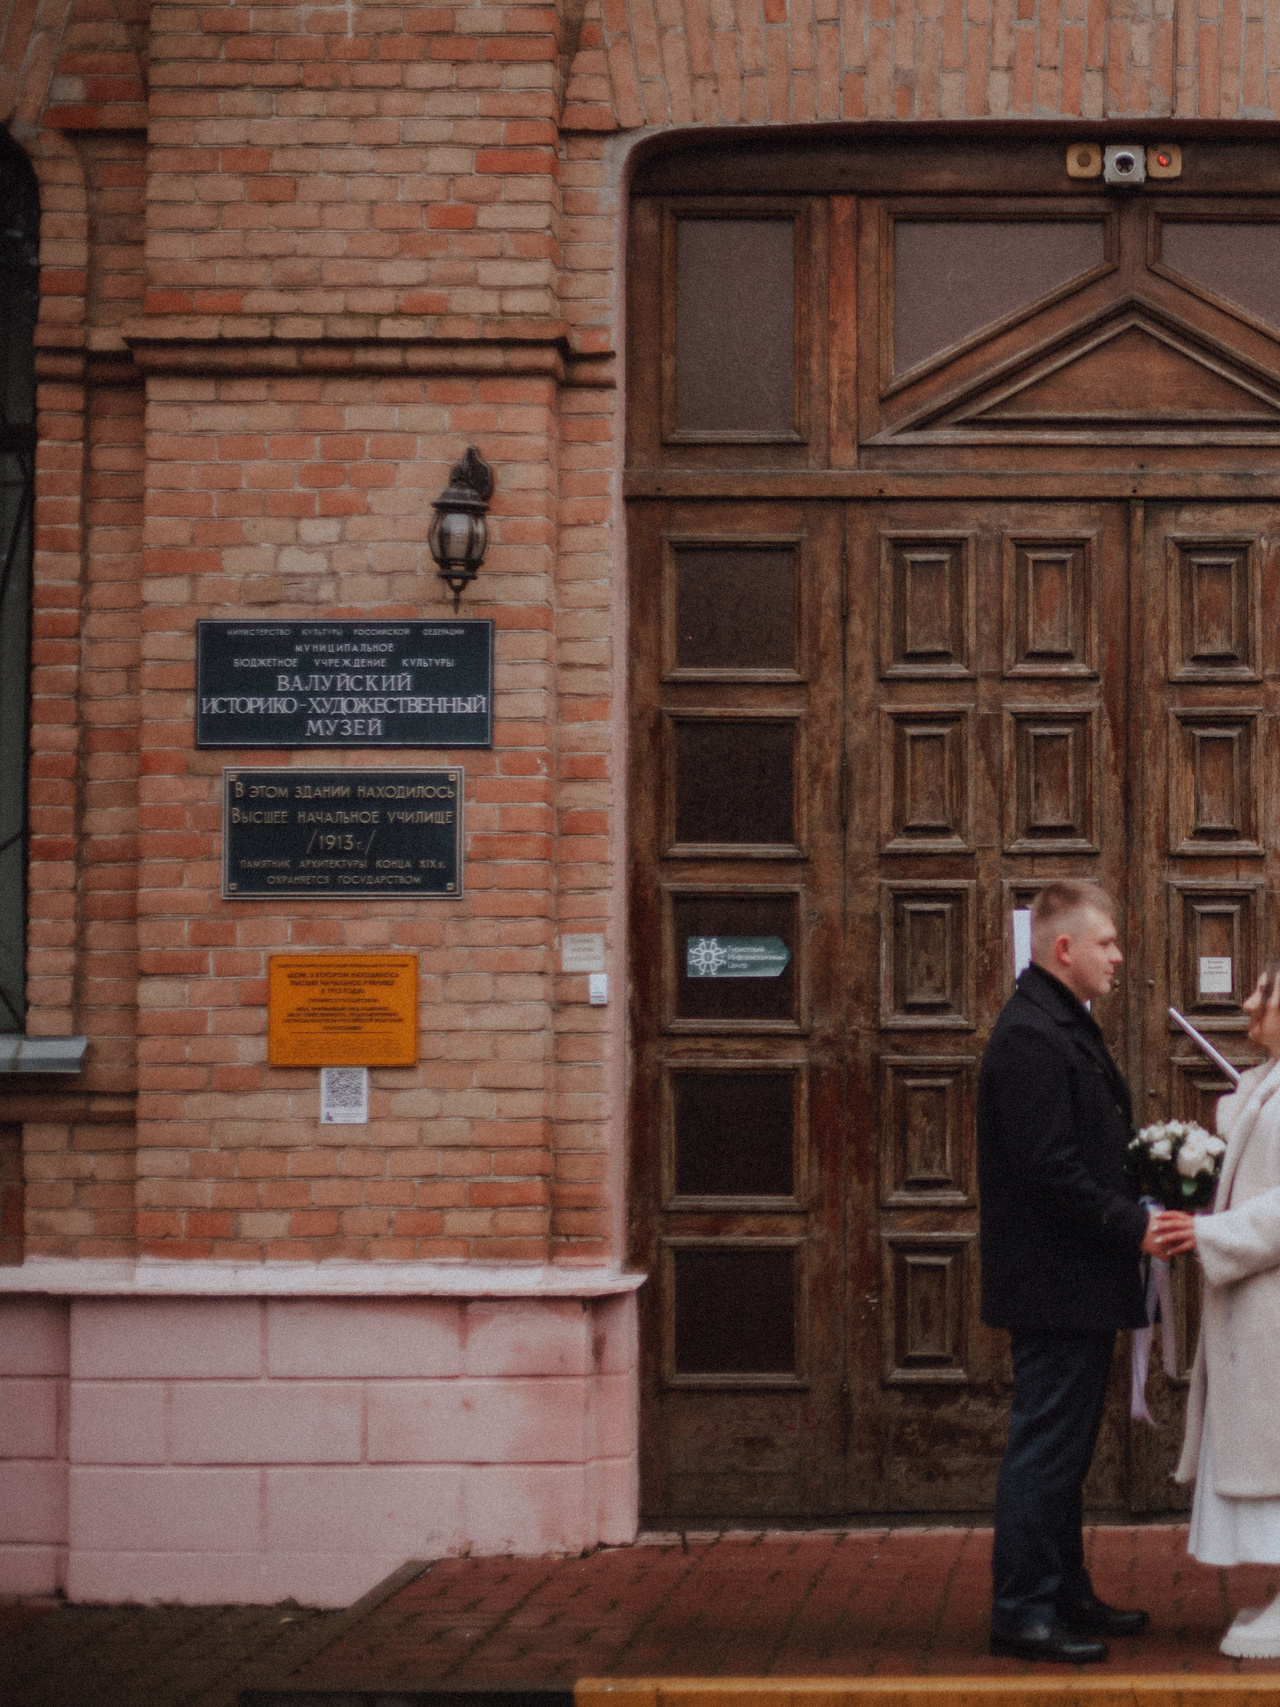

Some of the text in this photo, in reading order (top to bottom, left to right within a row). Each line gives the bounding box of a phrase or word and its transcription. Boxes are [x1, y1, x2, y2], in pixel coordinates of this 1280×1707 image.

[227, 627, 465, 636] МИНИСТЕРСТВО КУЛЬТУРЫ РОССИЙСКОЙ ФЕДЕРАЦИИ
[295, 643, 394, 653] МУНИЦИПАЛЬНОЕ
[233, 658, 455, 668] БЮДЖЕТНОЕ УЧРЕЖДЕНИЕ КУЛЬТУРЫ
[277, 672, 412, 691] ВАЛУЙСКИЙ
[305, 718, 382, 736] МУЗЕЙ
[235, 781, 455, 799] В ЭТОМ ЗДАНИИ НАХОДИЛОСЬ
[297, 811, 379, 824] НАЧАЛЬНОЕ
[387, 811, 453, 825] УЧИЛИЩЕ
[240, 860, 291, 869] ПАМЯТНИК
[299, 860, 367, 869] АРХИТЕКТУРЫ
[375, 859, 412, 869] КОНЦА
[266, 875, 421, 885] ОХРАНЯЕТСЯ ГОСУДАРСТВОМ
